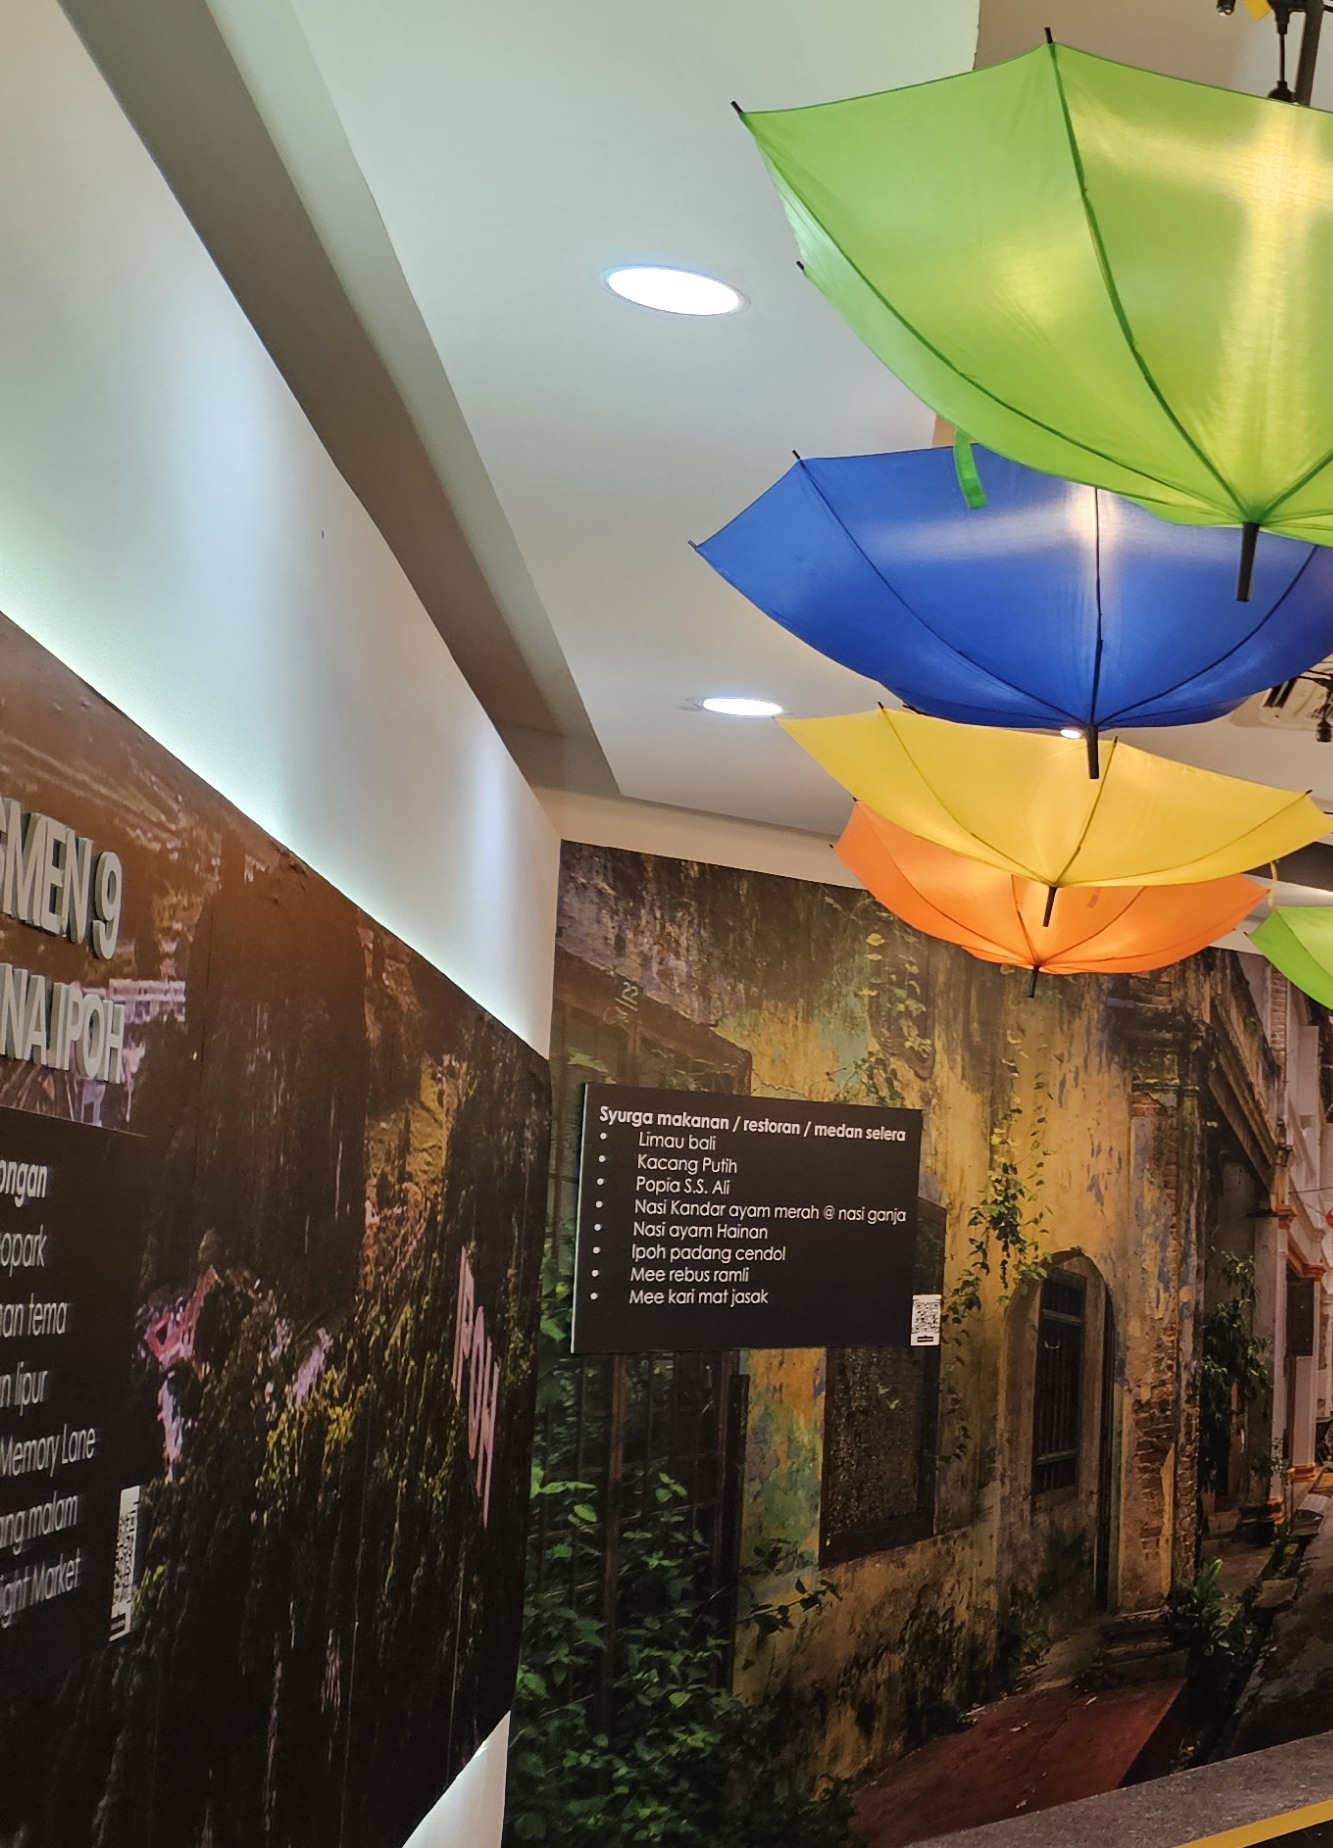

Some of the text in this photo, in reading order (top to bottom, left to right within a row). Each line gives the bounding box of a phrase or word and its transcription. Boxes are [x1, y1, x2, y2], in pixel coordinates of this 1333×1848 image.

[0, 795, 123, 960] MEN 9
[48, 982, 125, 1085] IPOH
[600, 1106, 906, 1142] Syurga makanan / restoran / medan selera
[639, 1131, 716, 1151] Limau bali
[637, 1154, 738, 1175] Kacang Putih
[636, 1176, 731, 1196] Popia S.S. Ali
[634, 1199, 907, 1225] Nasi Kandar ayam merah @ nasi ganja
[633, 1221, 768, 1241] Nasi ayam Hainan
[0, 1224, 48, 1277] opark
[631, 1243, 787, 1264] Ipoh padang cendol
[630, 1267, 750, 1283] Mee rebus ramli
[27, 1292, 68, 1336] tema
[629, 1288, 769, 1308] Mee kari mat jasak
[14, 1361, 49, 1416] lipur
[62, 1423, 96, 1464] Lane
[27, 1491, 79, 1540] malam
[30, 1548, 81, 1606] Market
